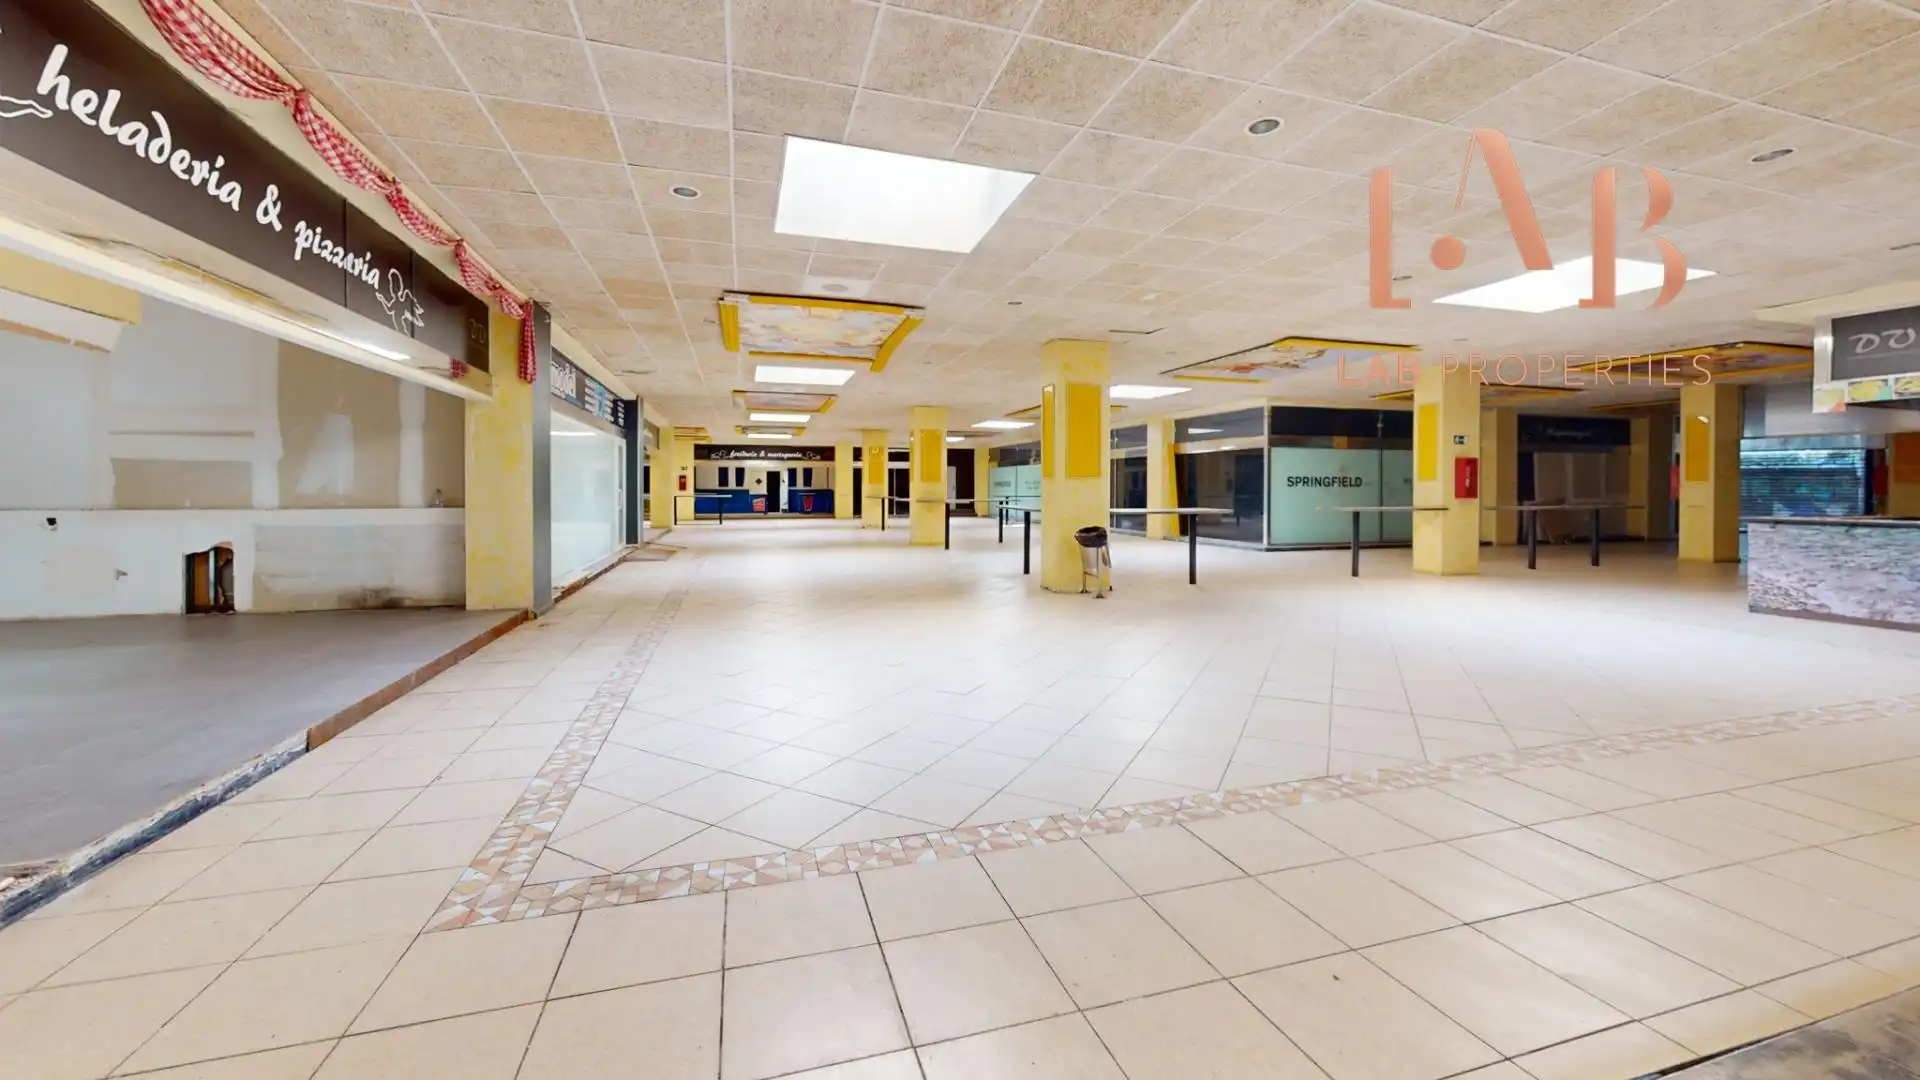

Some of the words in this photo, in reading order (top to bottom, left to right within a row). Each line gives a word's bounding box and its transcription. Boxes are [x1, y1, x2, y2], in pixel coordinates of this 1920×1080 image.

[36, 43, 243, 212] heladeria
[255, 184, 283, 231] &
[1287, 476, 1363, 487] SPRINGFIELD
